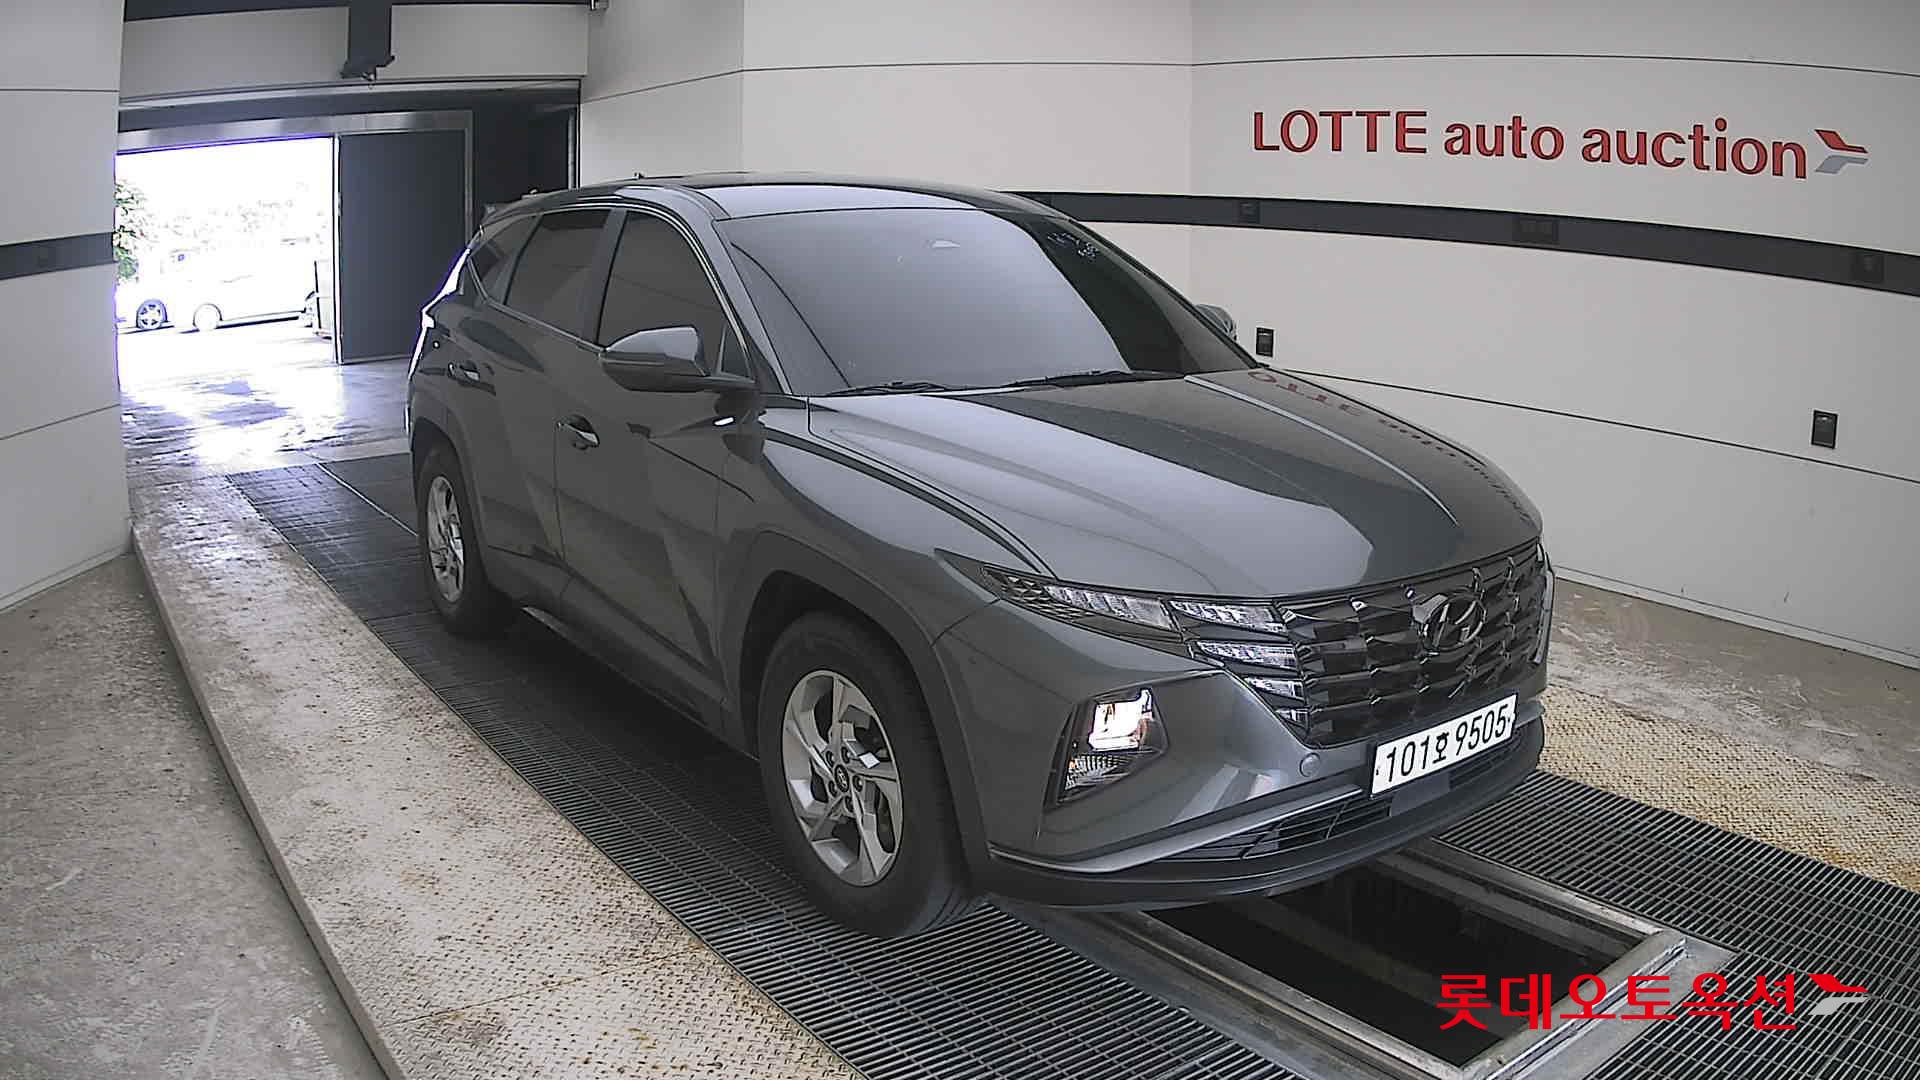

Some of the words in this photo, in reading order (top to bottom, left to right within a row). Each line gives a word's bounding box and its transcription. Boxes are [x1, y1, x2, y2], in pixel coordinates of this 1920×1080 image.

[1253, 110, 1427, 154] LOTTE
[1444, 115, 1565, 160] auto
[1582, 117, 1807, 179] auction
